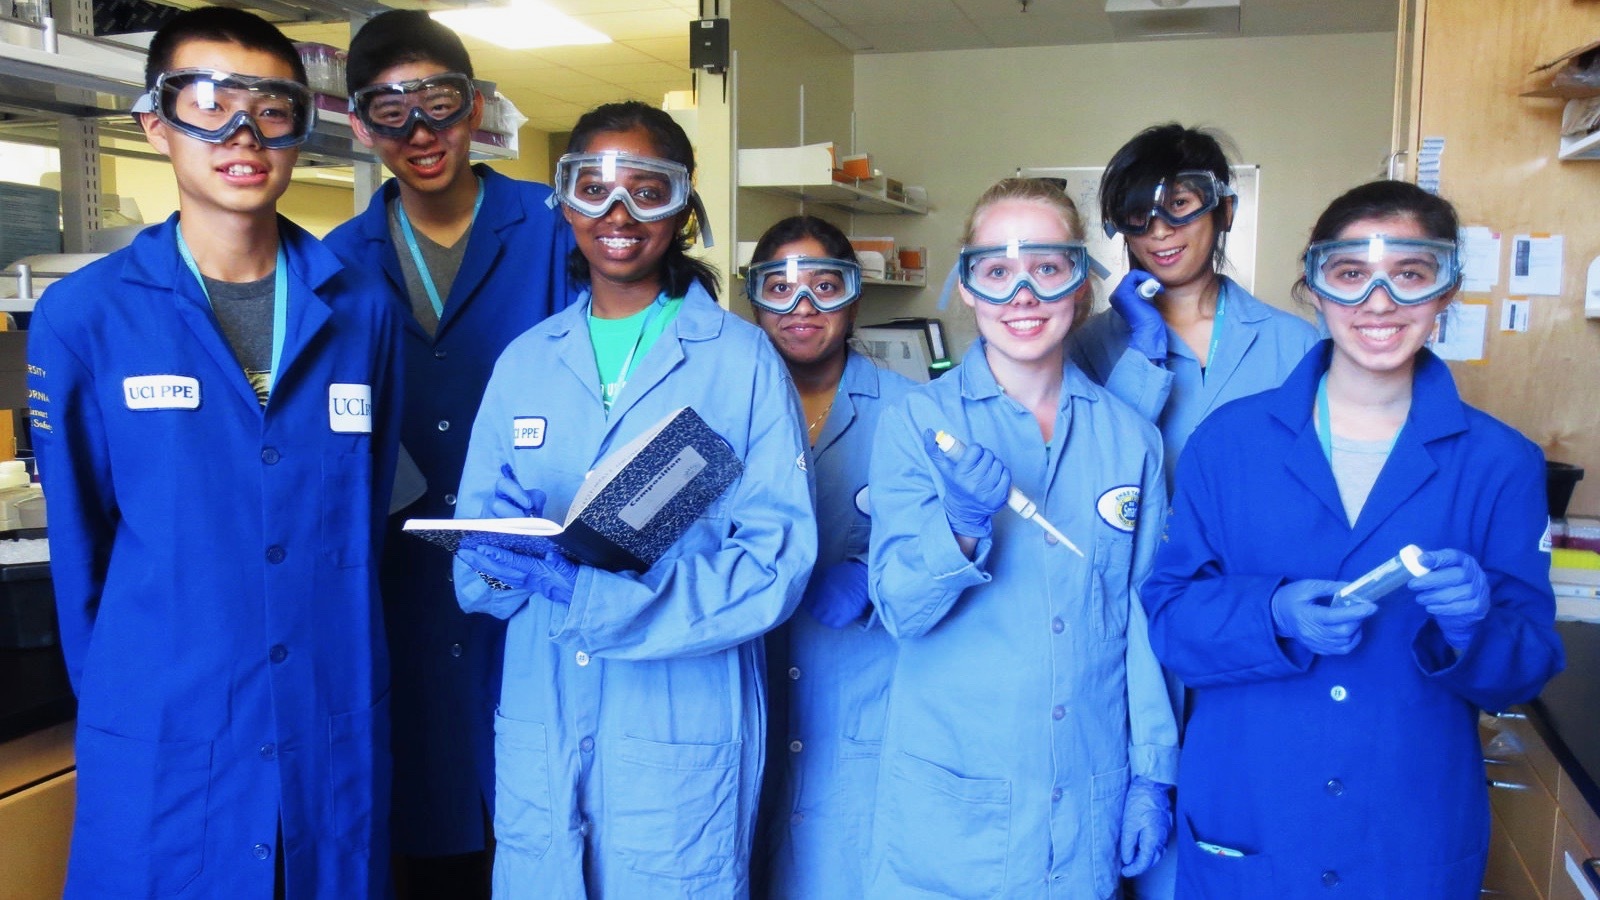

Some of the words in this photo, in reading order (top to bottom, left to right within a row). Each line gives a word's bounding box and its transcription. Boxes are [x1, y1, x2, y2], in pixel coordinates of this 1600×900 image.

[129, 386, 155, 399] UCI
[161, 385, 193, 398] PPE
[522, 427, 540, 439] PPE
[630, 457, 681, 506] Composition
